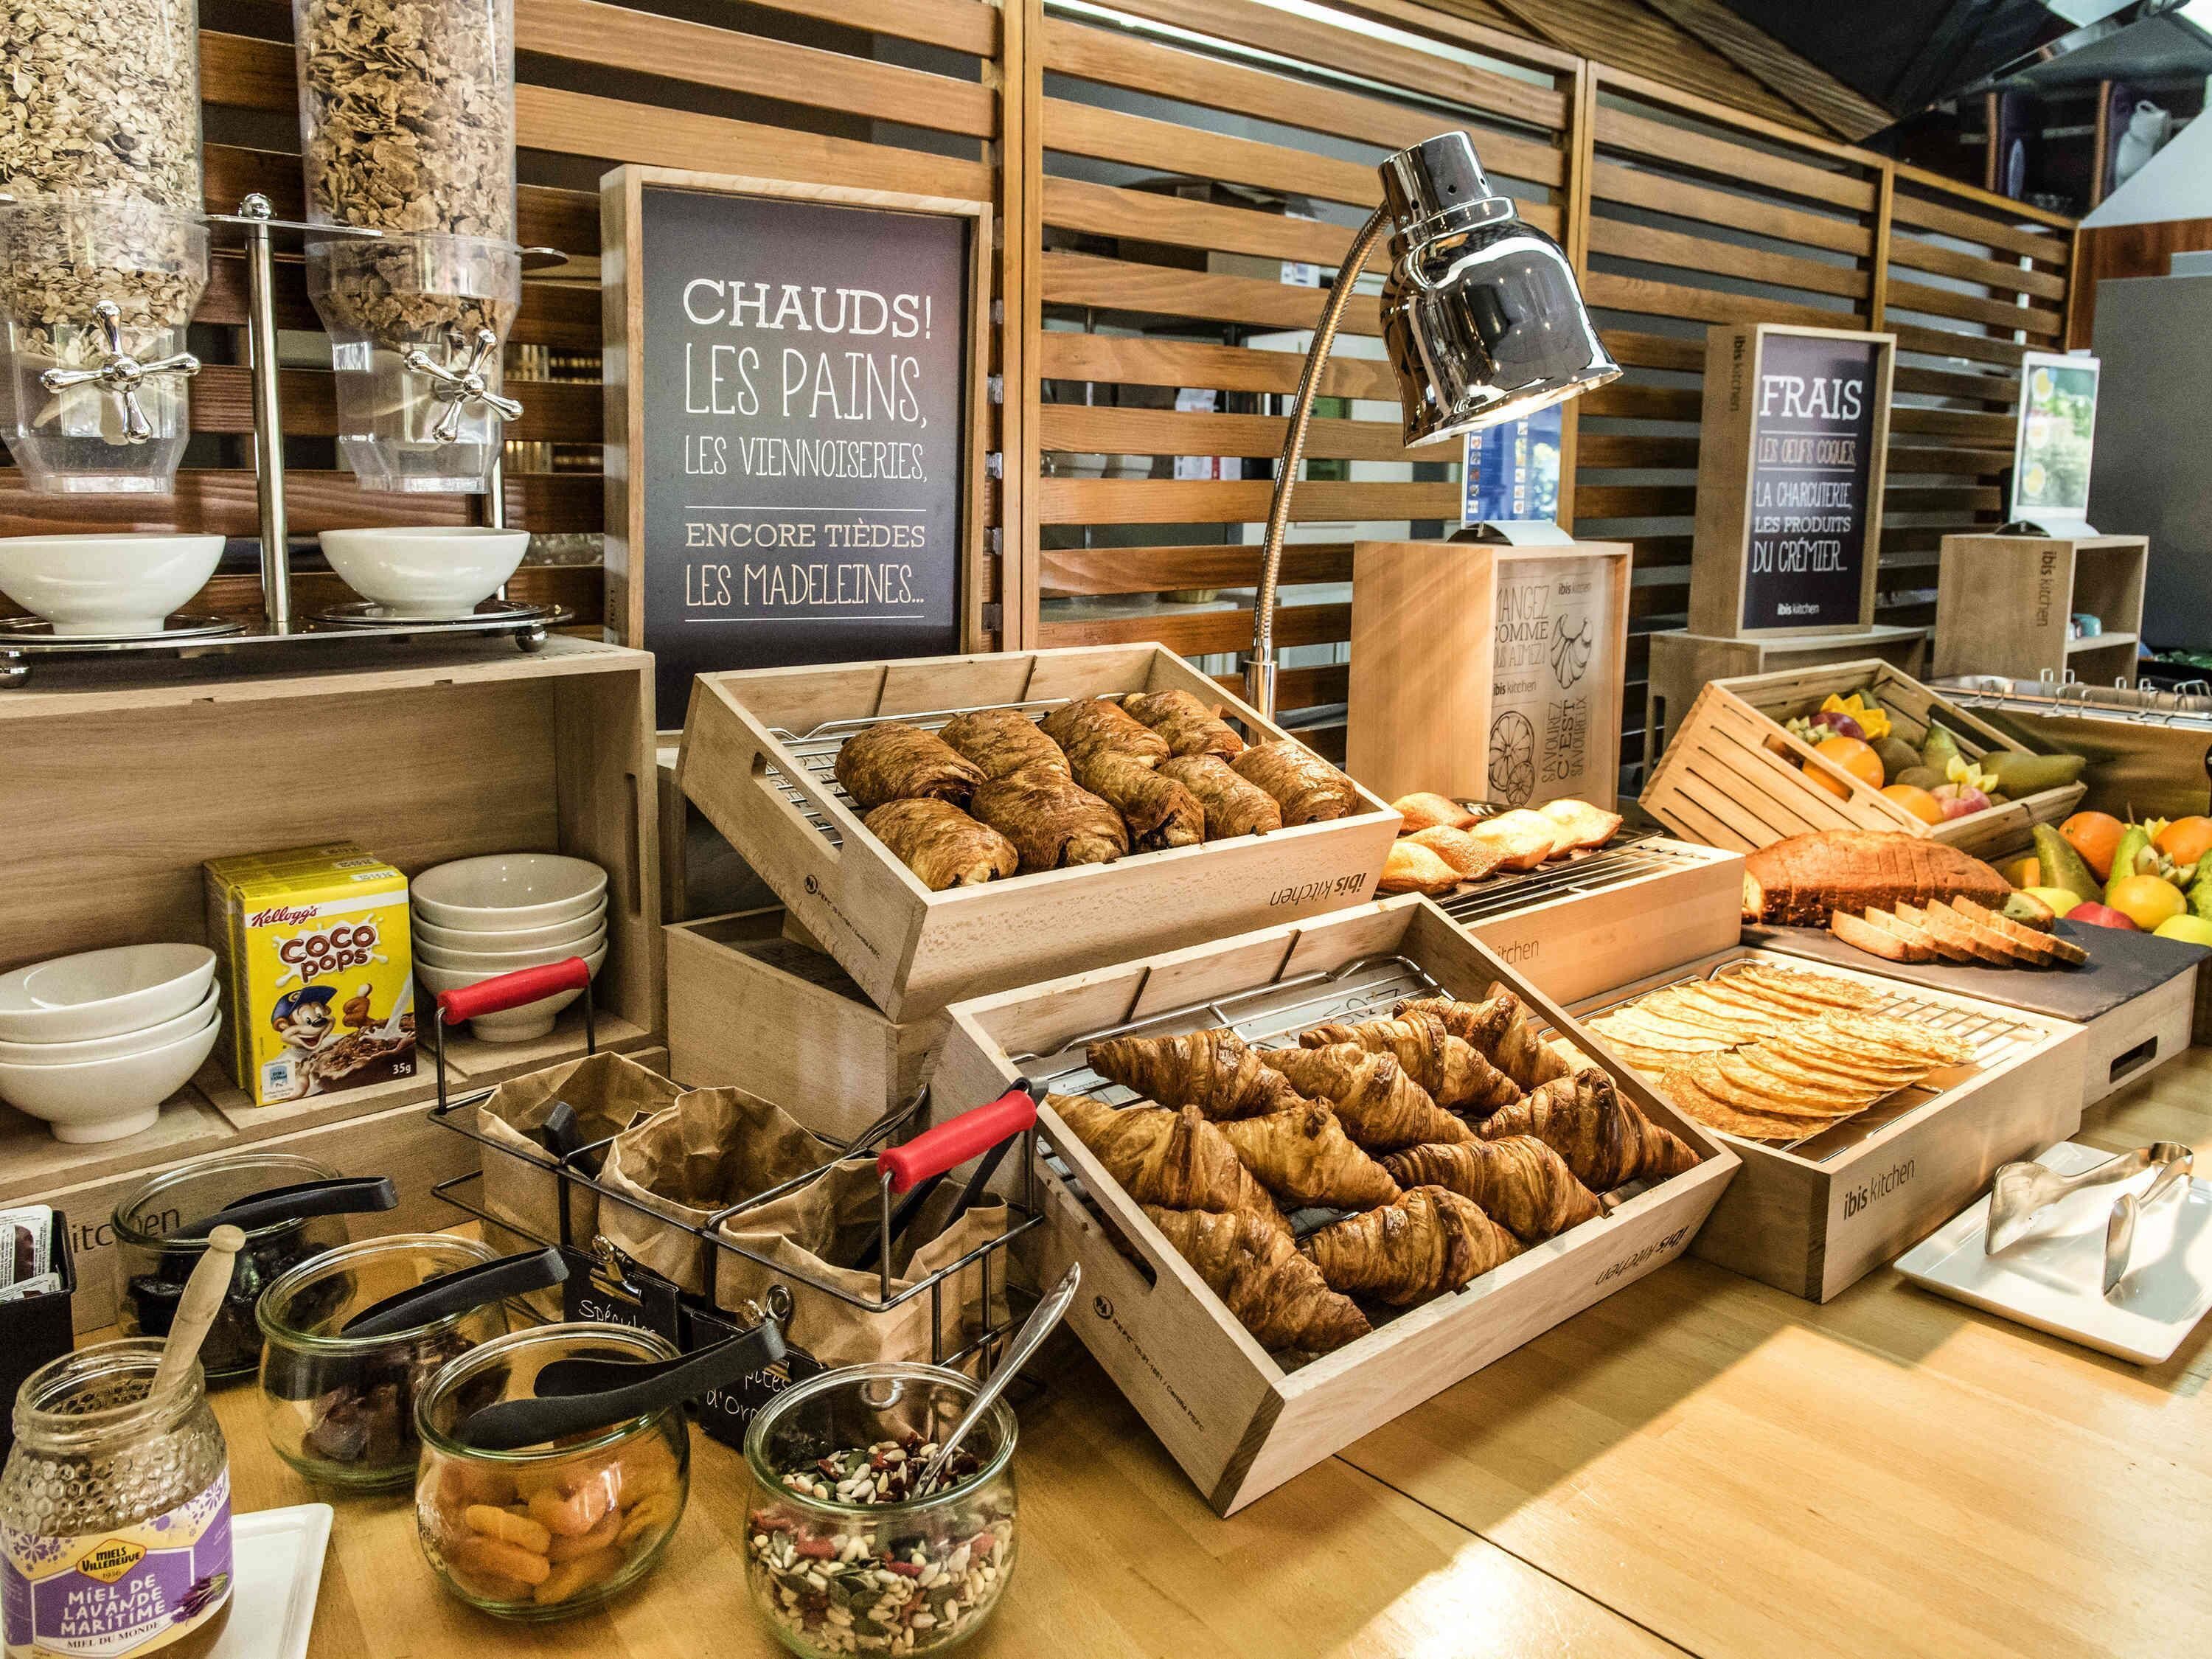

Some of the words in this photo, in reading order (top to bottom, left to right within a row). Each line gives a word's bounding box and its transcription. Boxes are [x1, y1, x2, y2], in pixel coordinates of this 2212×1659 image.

[683, 279, 932, 338] CHAUDS!
[685, 343, 759, 415] LES
[782, 348, 926, 428] PAINS,
[1759, 375, 1863, 420] FRAIS
[685, 435, 727, 475] LES
[739, 437, 927, 482] VIENNOISERIES,
[1758, 437, 1778, 463] LES
[1755, 481, 1771, 507] LA
[685, 523, 815, 548] ENCORE
[825, 518, 925, 548] TIÈDES
[1754, 516, 1780, 532] LES
[1783, 516, 1851, 532] PRODUITS
[1752, 541, 1773, 573] DU
[2041, 551, 2056, 575] ibis
[685, 564, 731, 606] LES
[744, 564, 924, 605] MADELEINES...
[1777, 603, 1792, 615] ibis
[1495, 622, 1548, 643] OMME
[1542, 702, 1562, 782] SAVOUREZ
[1557, 700, 1575, 779] C'EST
[1270, 880, 1333, 906] kitchen
[1334, 873, 1366, 896] ibis
[251, 905, 319, 927] Kellogg's
[1498, 941, 1539, 964] itchen
[392, 1063, 411, 1074] 35g
[1843, 1186, 1868, 1220] ibis
[1870, 1160, 1915, 1203] kitchen
[72, 1208, 181, 1253] itcen
[1655, 1225, 1689, 1253] ibis
[1595, 1242, 1659, 1285] kitchen
[130, 1573, 156, 1594] DE
[63, 1586, 162, 1620] LAVANDE
[67, 1638, 96, 1648] MIEL
[100, 1636, 116, 1645] DU
[119, 1621, 160, 1640] MONDE
